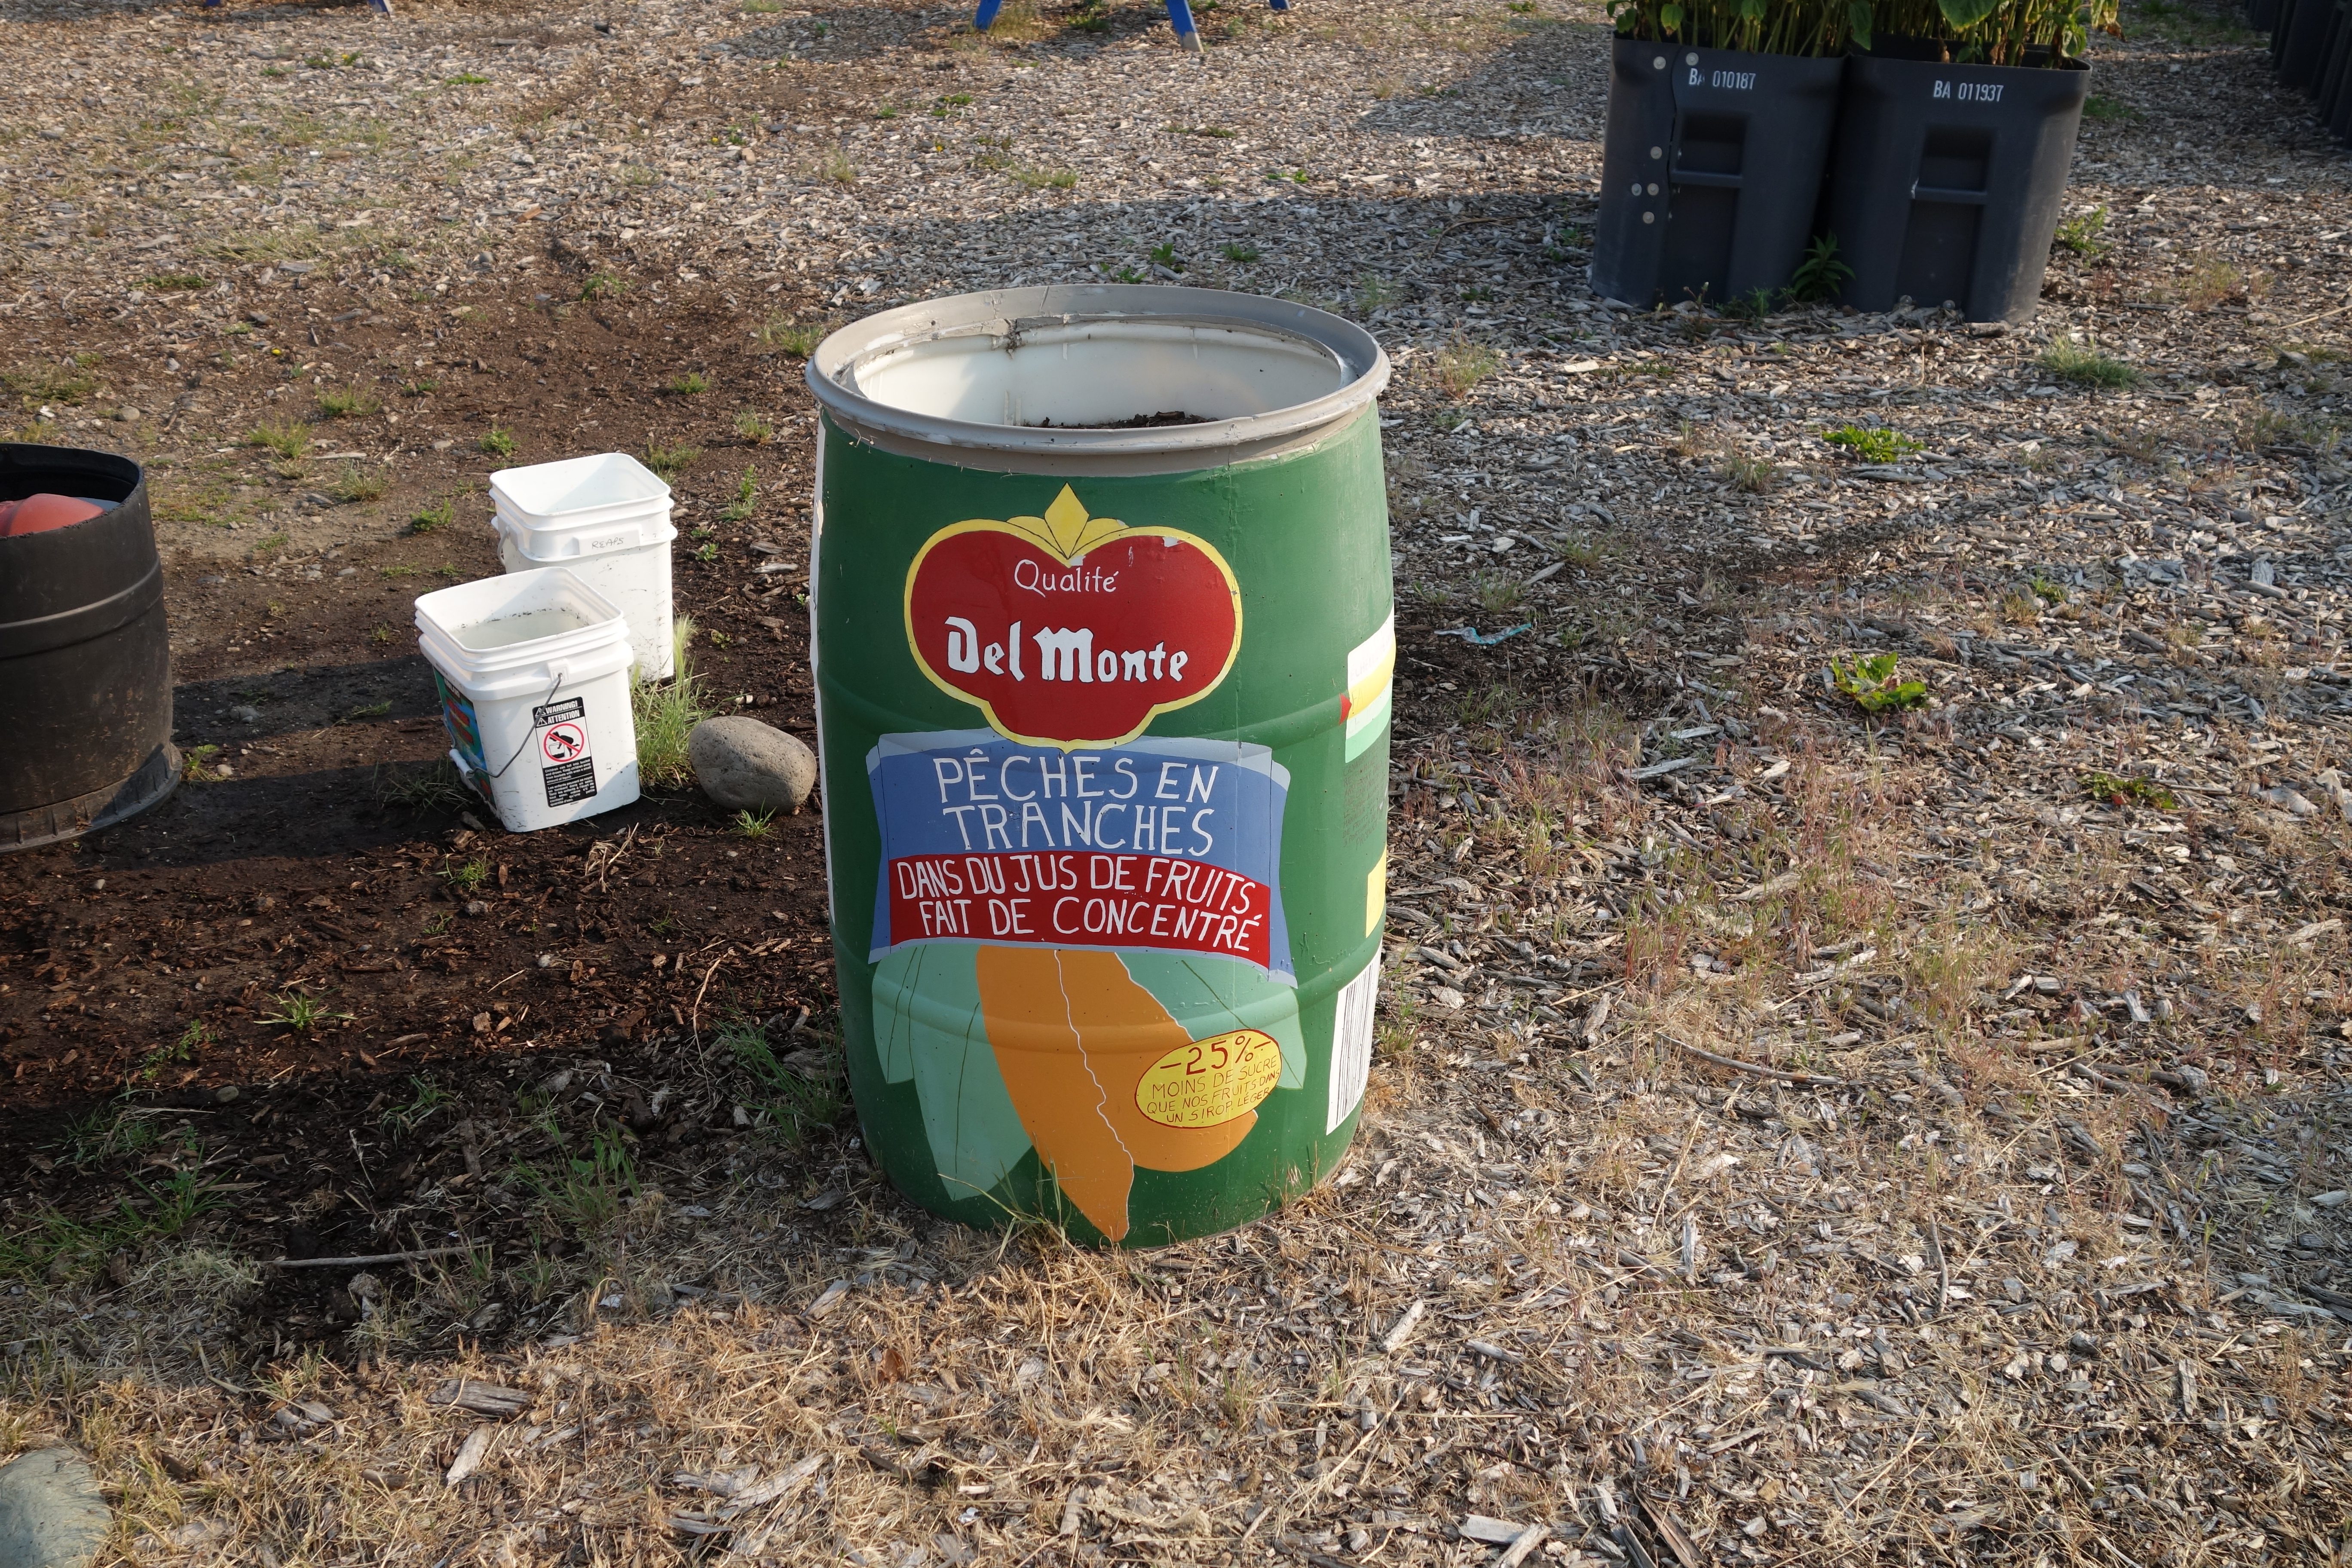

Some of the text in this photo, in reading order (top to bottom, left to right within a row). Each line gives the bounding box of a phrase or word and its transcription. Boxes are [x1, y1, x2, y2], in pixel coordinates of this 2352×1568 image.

[1712, 70, 1756, 90] 010187
[1934, 80, 2004, 101] BA 011937
[1014, 559, 1118, 597] Qualité
[945, 616, 1188, 683] Del Monte
[545, 700, 578, 714] WARNING!
[548, 710, 580, 724] ATTENTION
[933, 750, 1219, 803] PÊCHES EN
[943, 802, 1215, 856] TRANCHES
[897, 855, 1256, 914] DANS DU JUS DE FRUITS
[919, 897, 1262, 952] FAIT DE CONCENTRÉ
[1147, 1069, 1280, 1114] QUE NOS FRUITS DANS
[1152, 1055, 1277, 1099] MOINS DE SUCRE
[1167, 1115, 1183, 1123] UN
[1237, 1087, 1270, 1107] LÉGER
